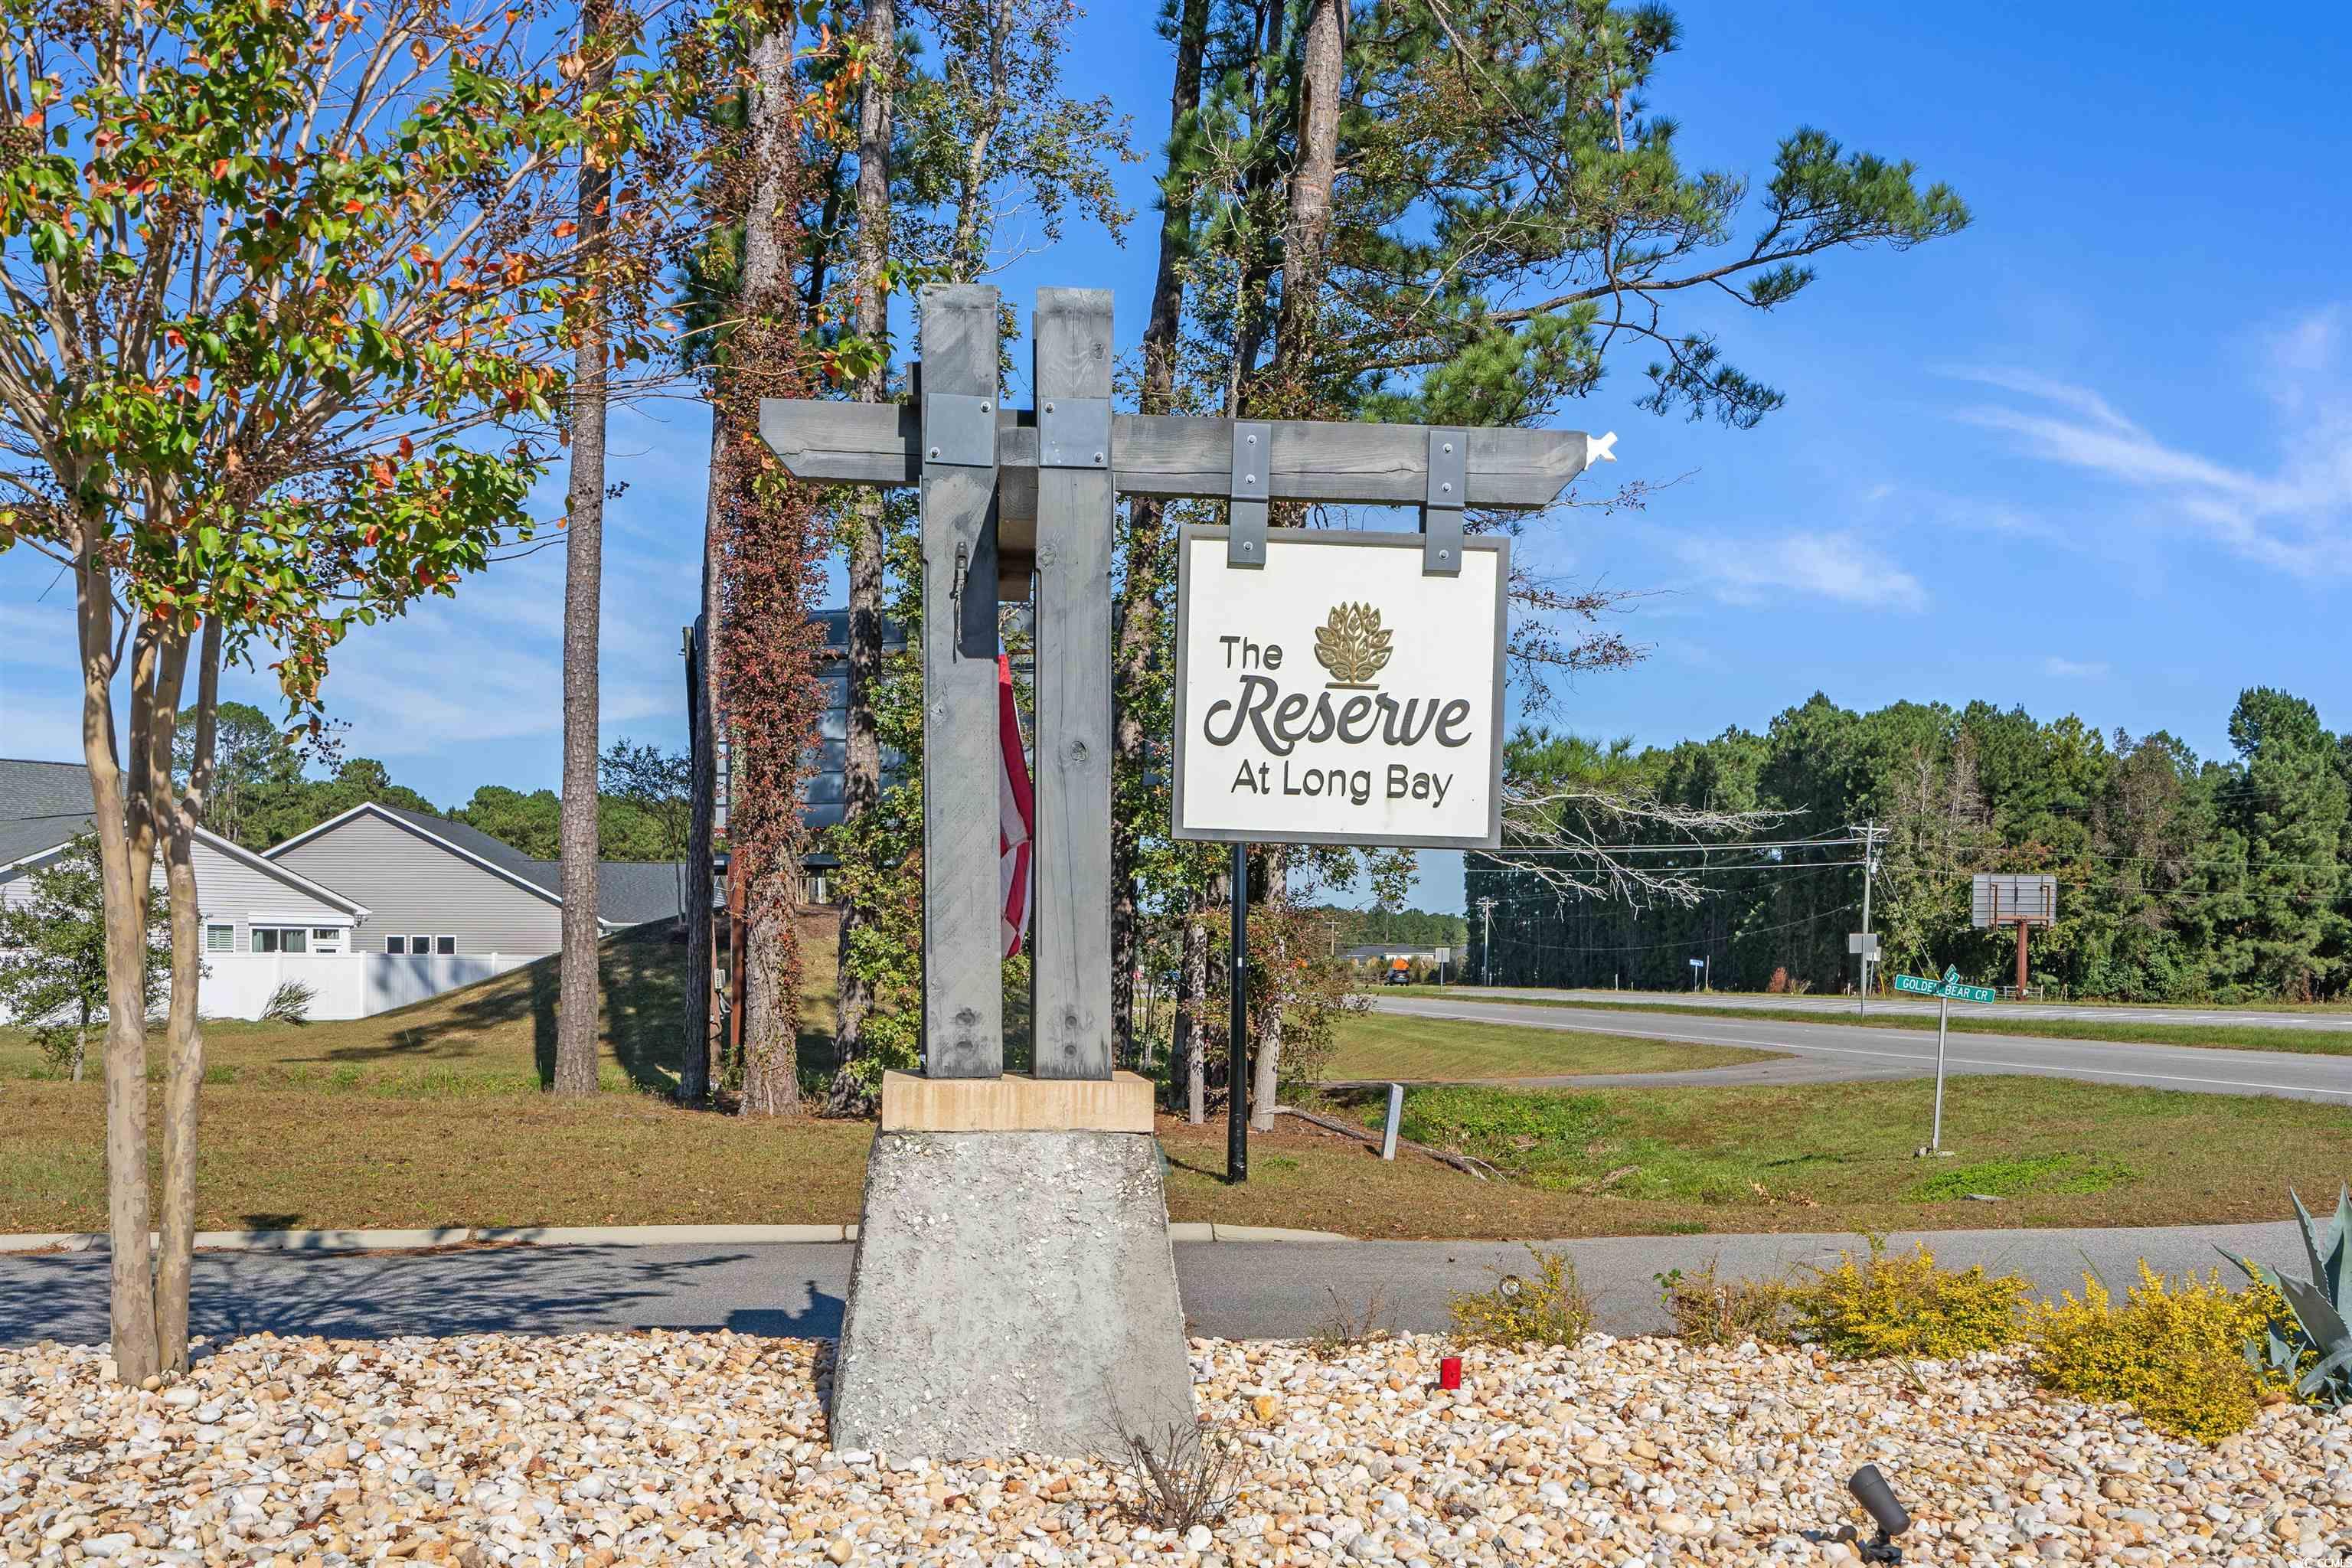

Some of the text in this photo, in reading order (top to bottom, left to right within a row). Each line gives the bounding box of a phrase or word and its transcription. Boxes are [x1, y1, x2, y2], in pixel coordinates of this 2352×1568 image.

[1220, 635, 1283, 670] The
[1204, 675, 1472, 756] Reserve
[1231, 759, 1453, 808] At Long Bay
[1945, 985, 1970, 998] BEAR
[1975, 989, 1988, 1001] CR
